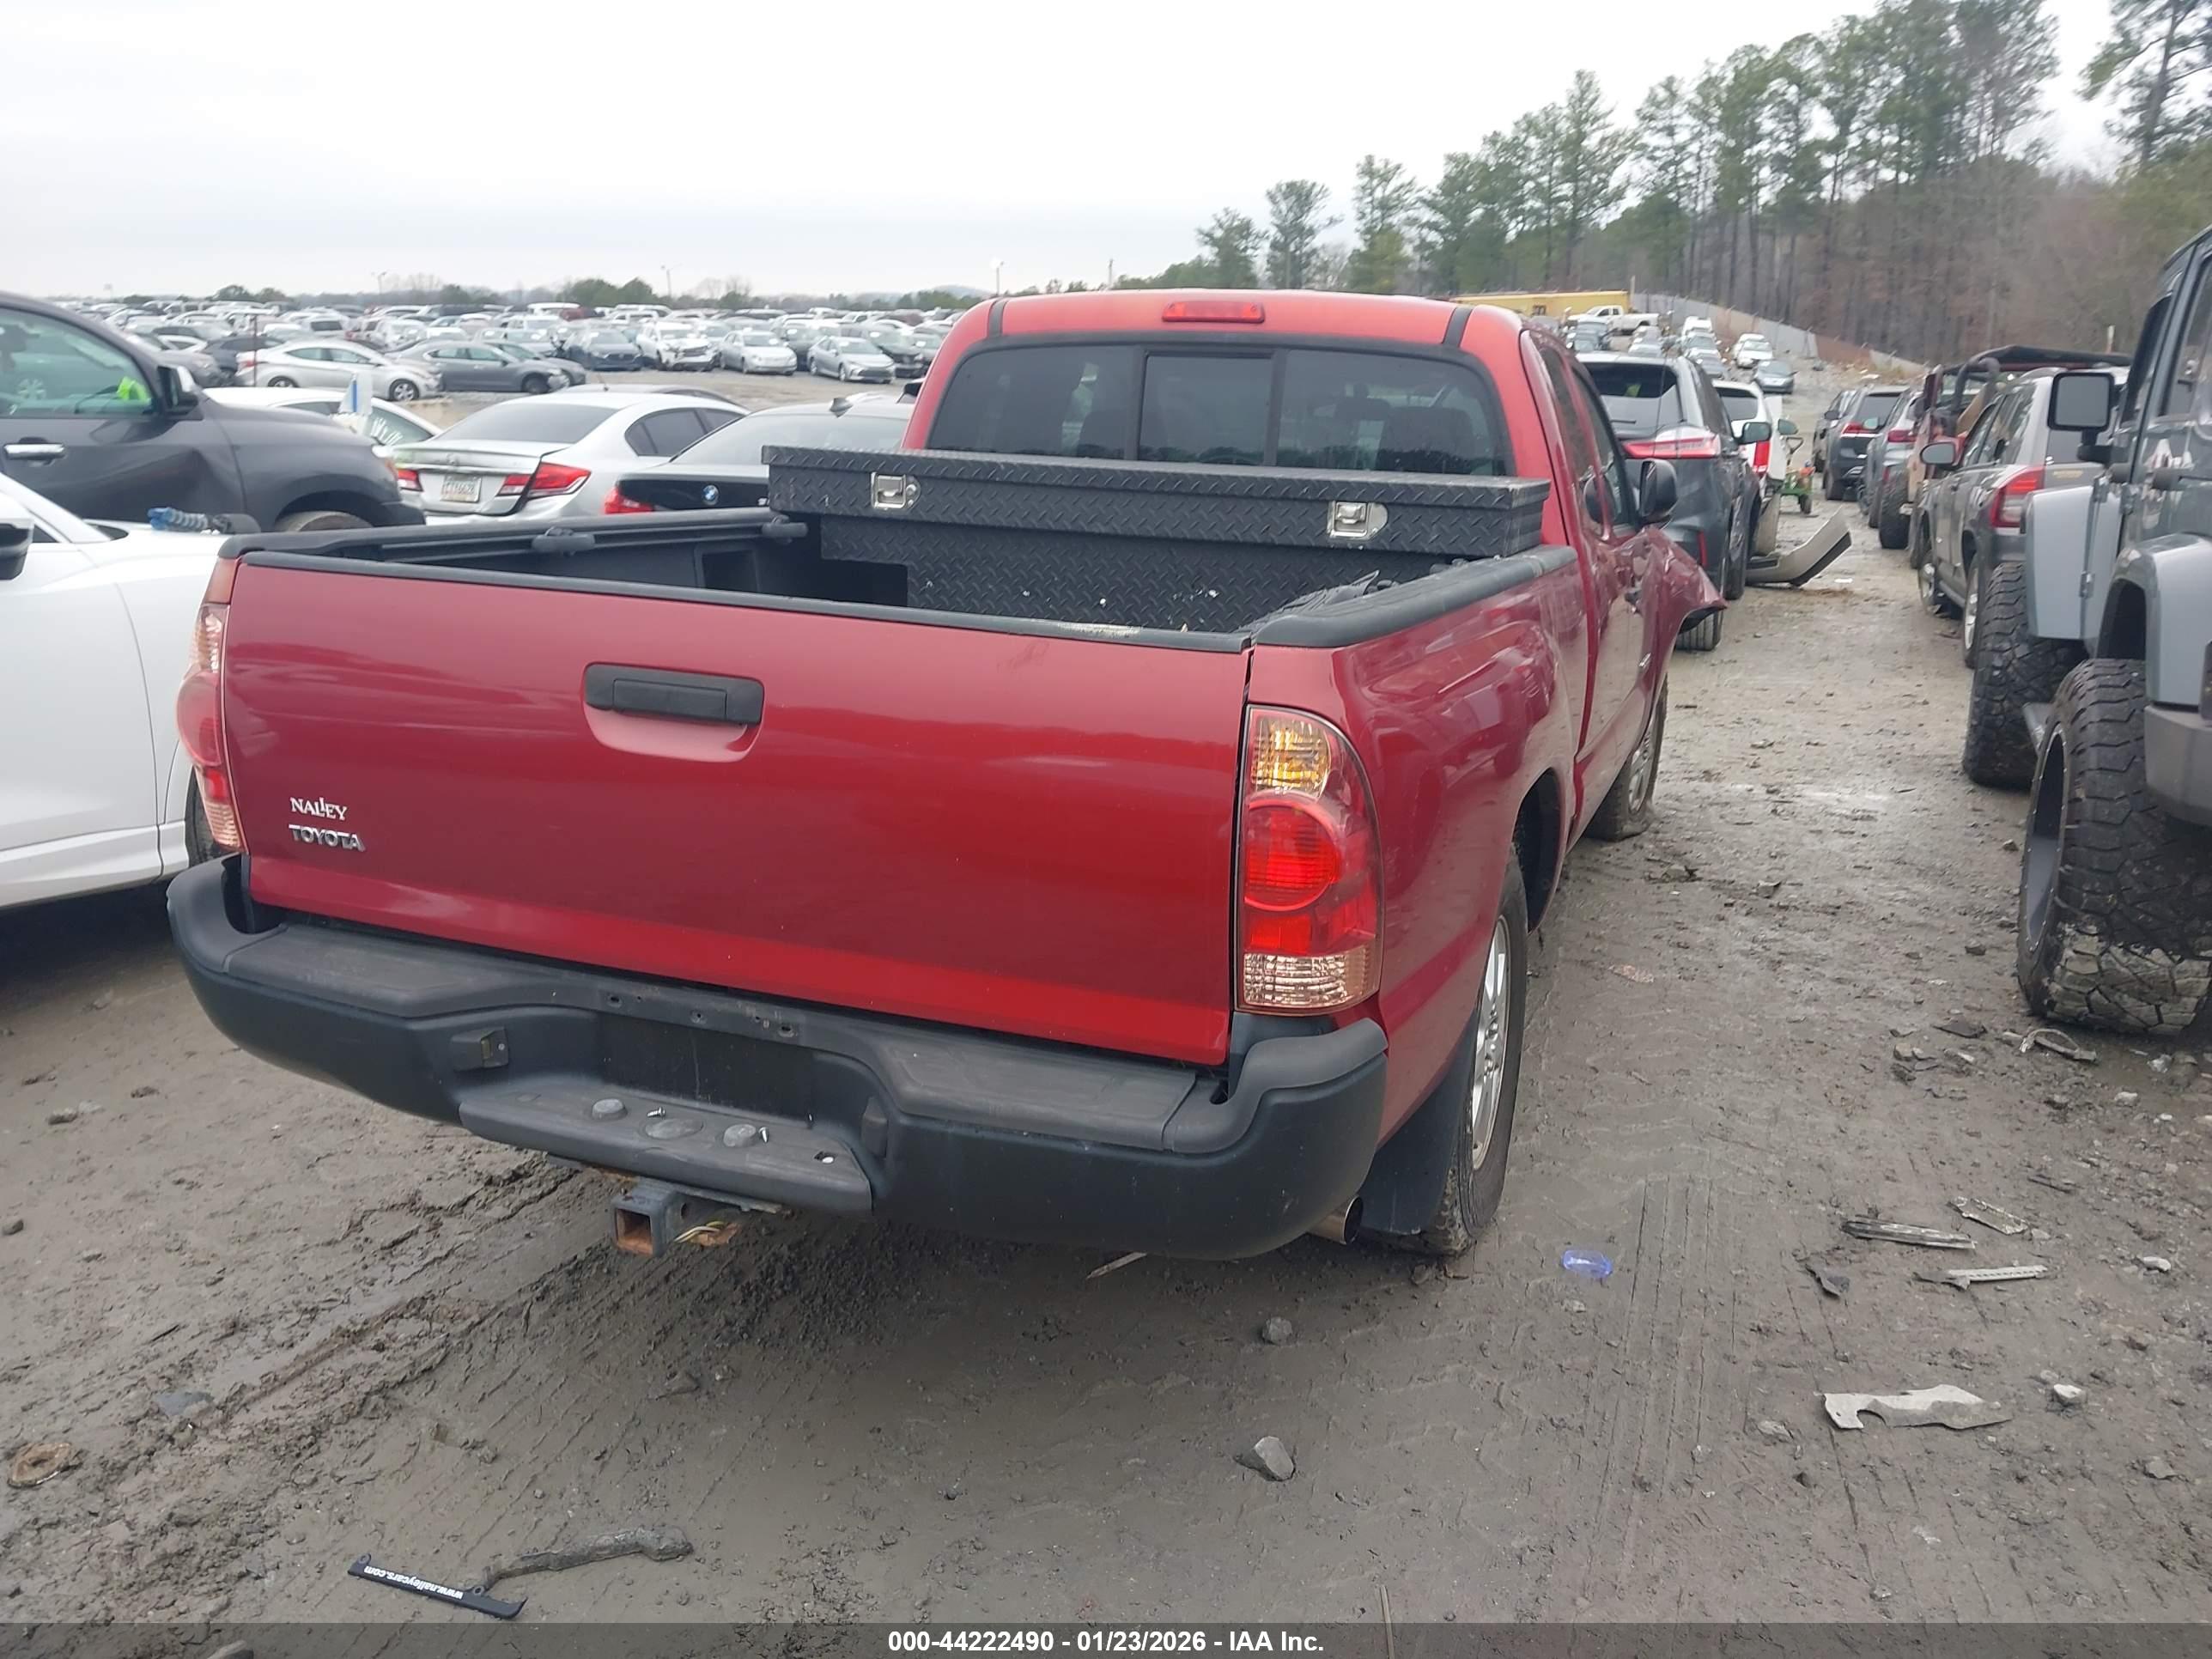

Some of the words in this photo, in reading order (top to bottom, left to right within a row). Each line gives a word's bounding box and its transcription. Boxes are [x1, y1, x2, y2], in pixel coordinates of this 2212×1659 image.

[290, 797, 347, 820] NALLEY
[289, 824, 366, 852] TOYOTA
[363, 1565, 464, 1599] www.nalleycars.com
